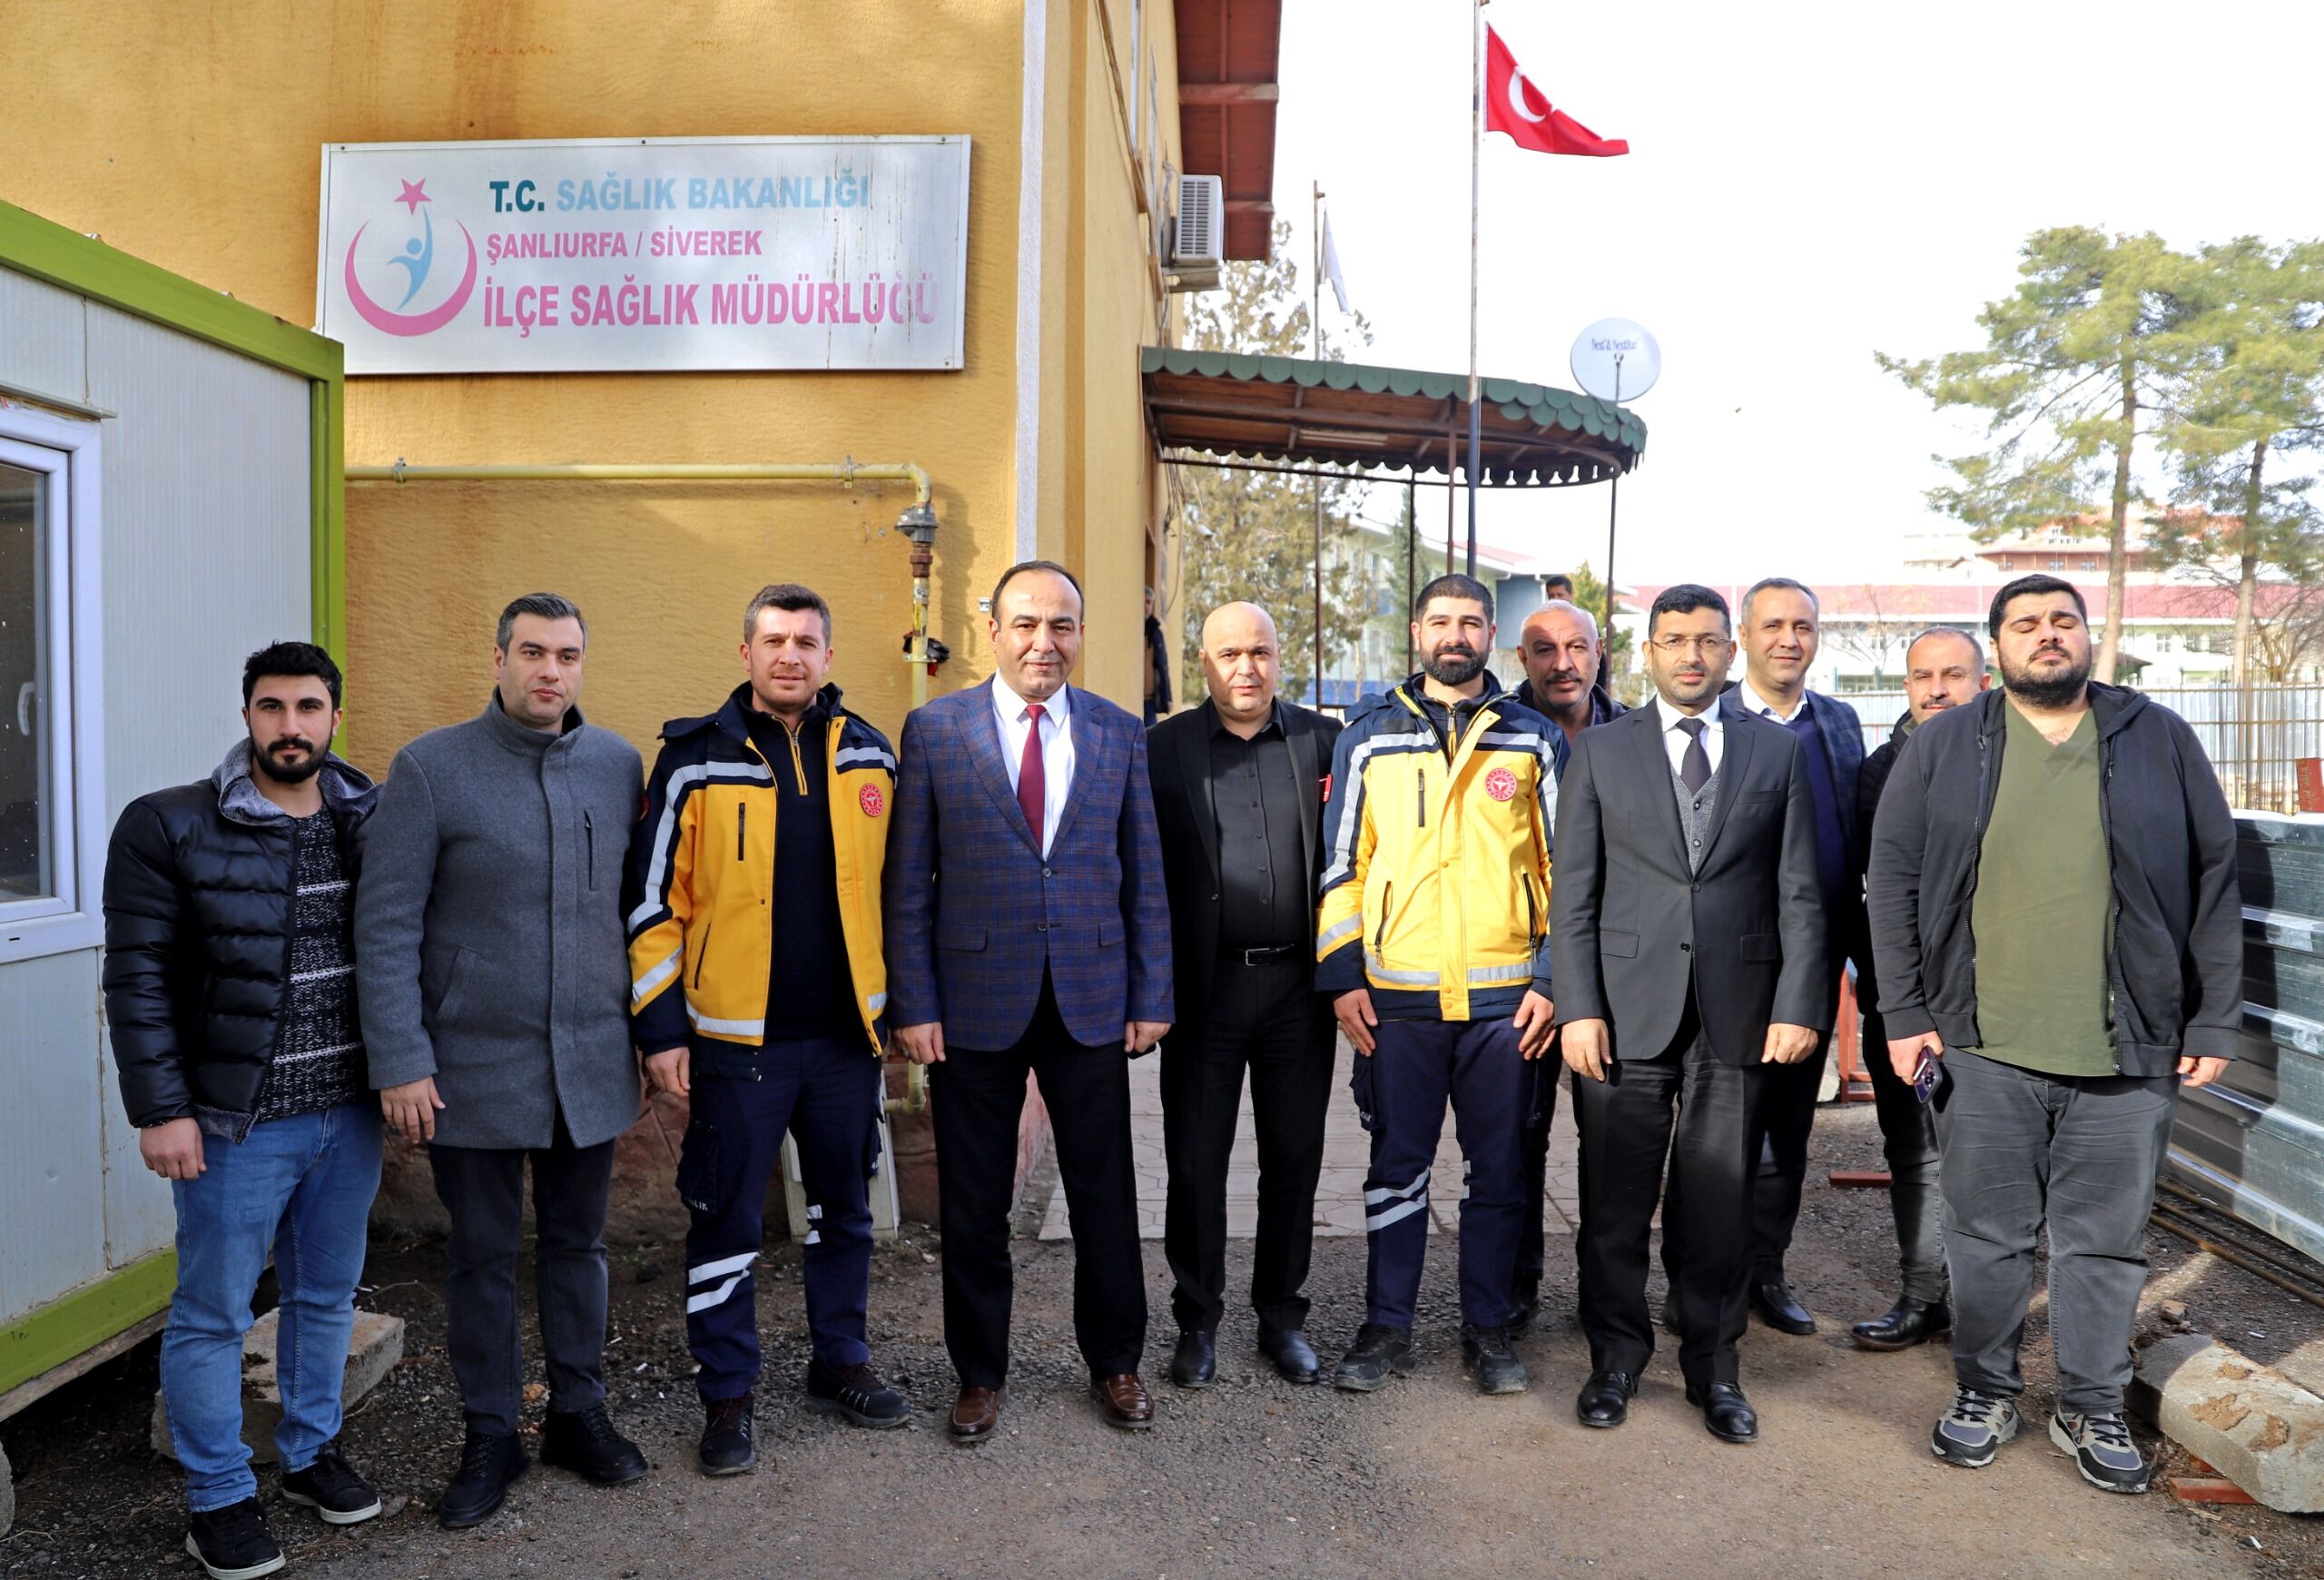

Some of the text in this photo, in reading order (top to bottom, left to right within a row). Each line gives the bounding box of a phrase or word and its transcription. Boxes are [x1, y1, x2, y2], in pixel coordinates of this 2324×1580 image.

[488, 167, 872, 214] T.C. SAĞLIK BAKANLIĞI
[486, 225, 763, 265] ŞANLIURFA / SİVEREK
[483, 276, 559, 339] İLÇE
[569, 274, 701, 328] SAĞLIK
